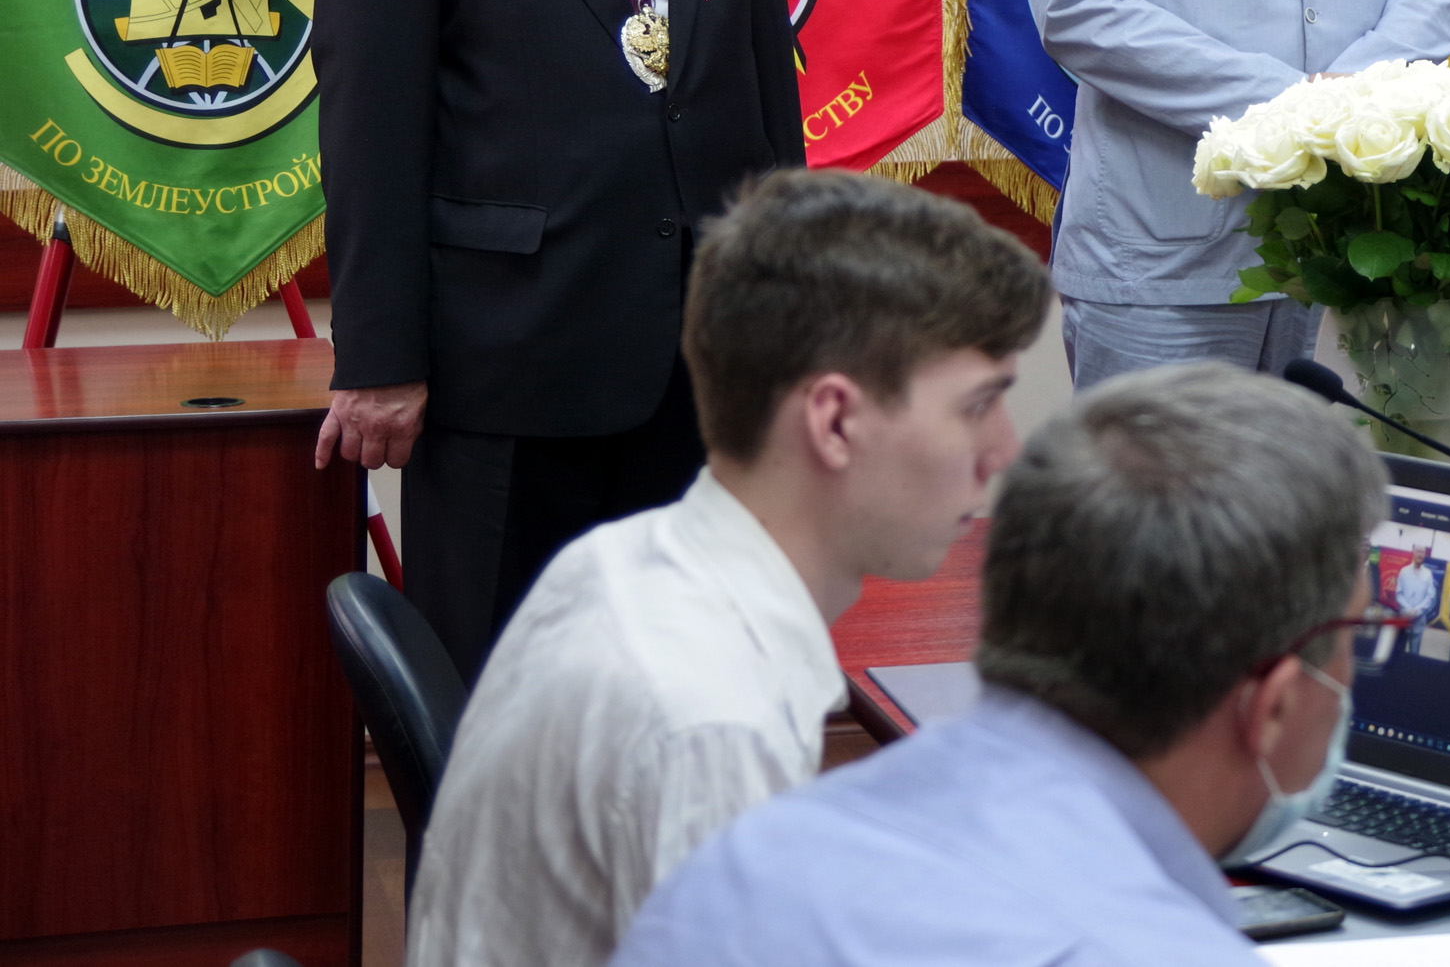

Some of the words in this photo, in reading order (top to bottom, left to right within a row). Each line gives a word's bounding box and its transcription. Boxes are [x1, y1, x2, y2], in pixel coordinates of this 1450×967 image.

[803, 69, 873, 148] СТВУ
[1026, 93, 1065, 139] ПО
[28, 118, 82, 168] ПО
[81, 152, 322, 215] ЗЕМЛЕУСТРОЙ
